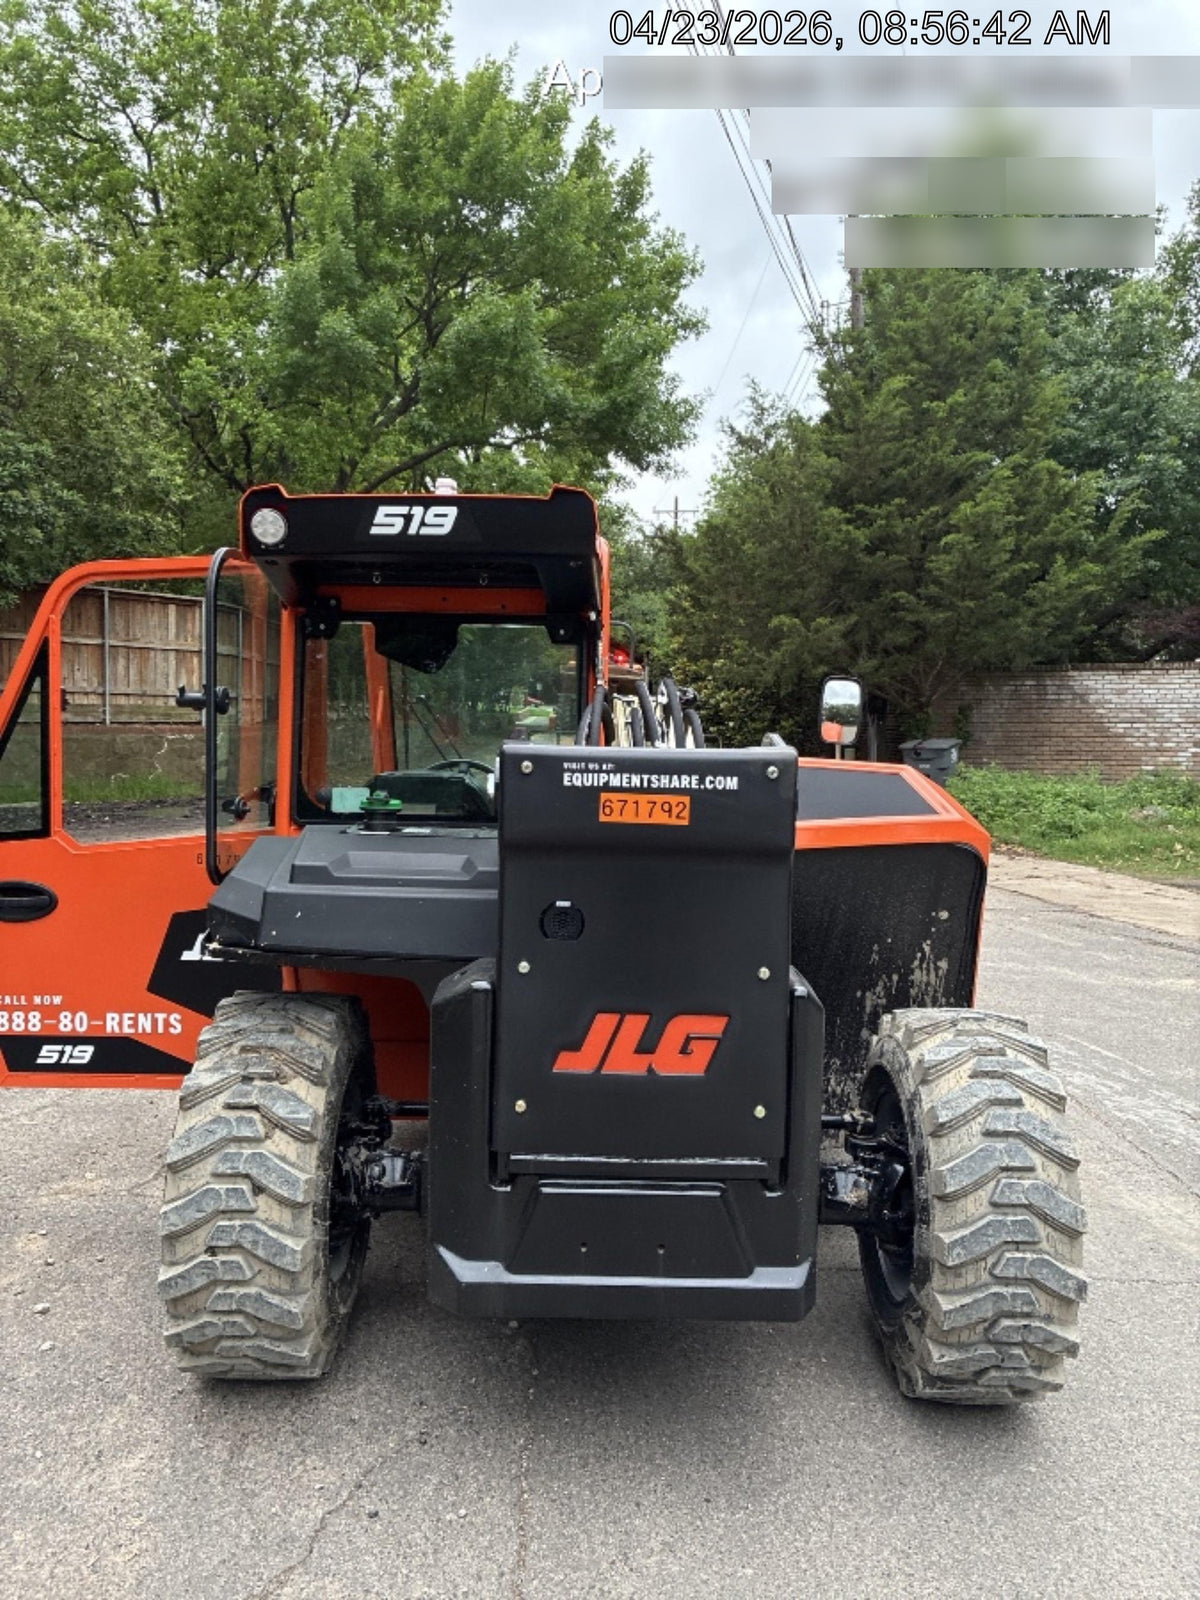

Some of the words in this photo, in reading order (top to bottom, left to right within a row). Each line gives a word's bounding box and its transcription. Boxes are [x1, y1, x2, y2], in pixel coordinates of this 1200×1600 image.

[369, 505, 458, 536] 519
[563, 772, 739, 790] EQUIPMENTSHARE.COM
[602, 798, 688, 821] 671792
[33, 995, 63, 1006] NOW
[35, 1044, 95, 1064] 519
[552, 1012, 730, 1076] JLG
